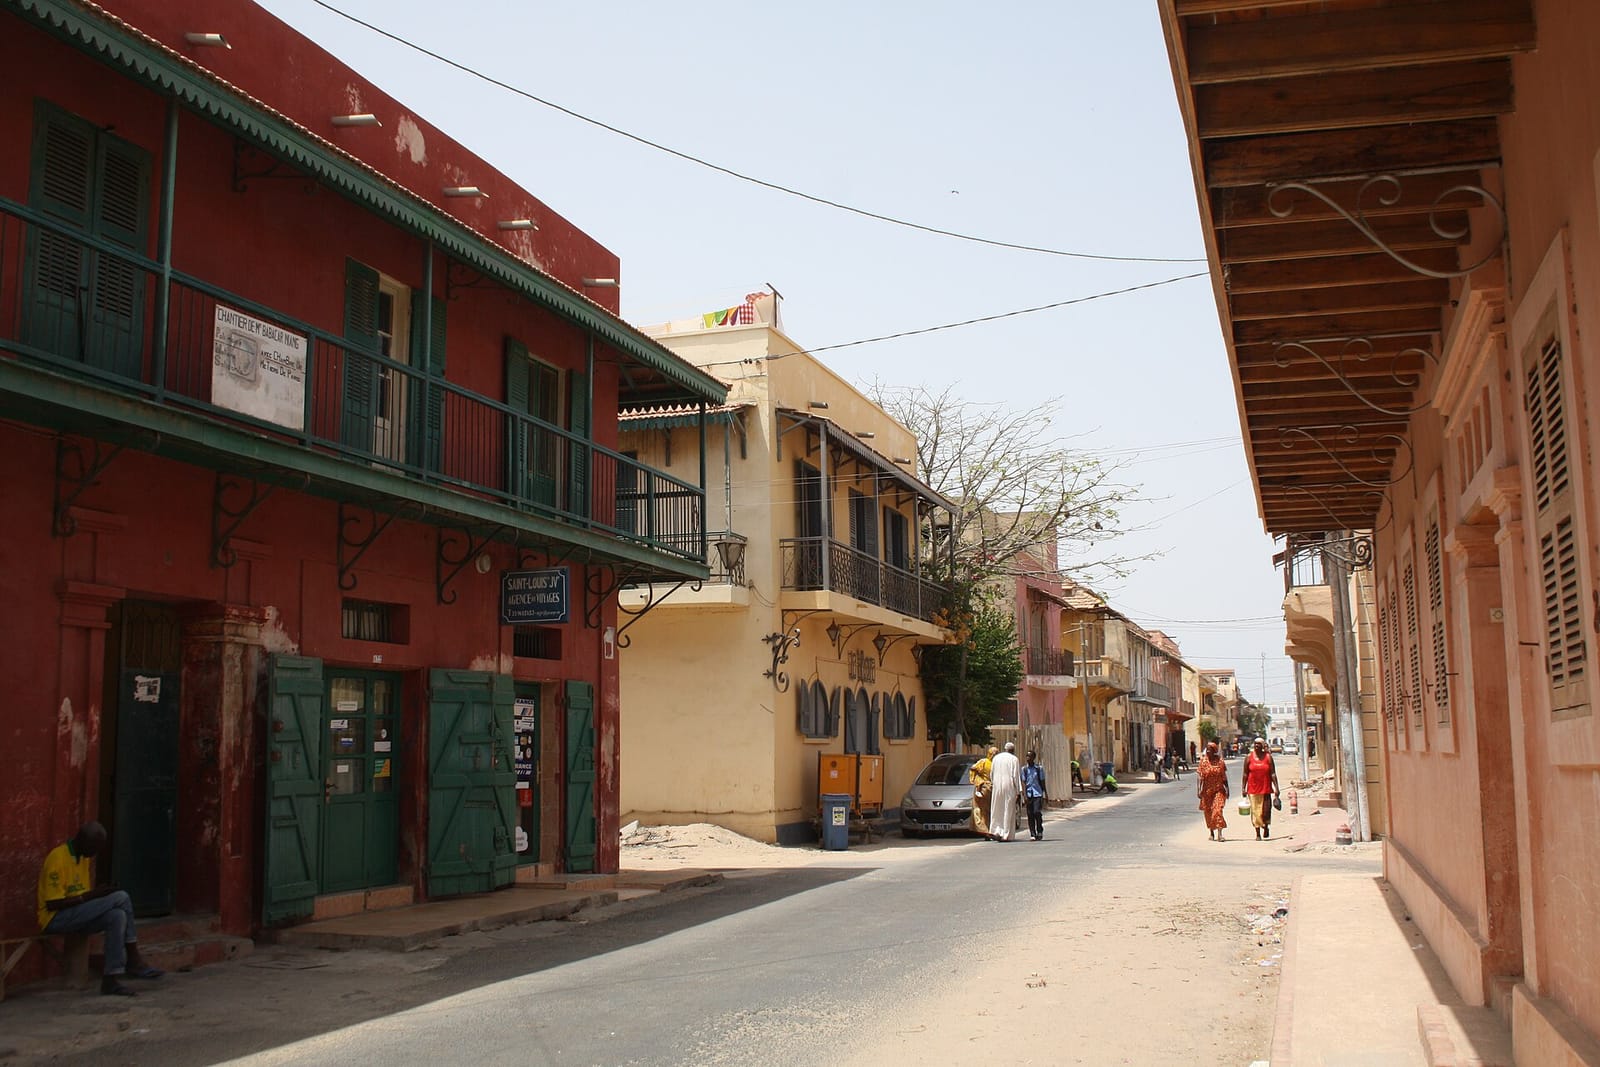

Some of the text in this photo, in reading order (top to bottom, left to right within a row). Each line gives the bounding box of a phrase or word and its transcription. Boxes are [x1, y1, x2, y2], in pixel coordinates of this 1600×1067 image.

[217, 308, 247, 329] CHANTIER
[508, 593, 532, 605] AGENCE
[536, 592, 560, 604] VOYAGES
